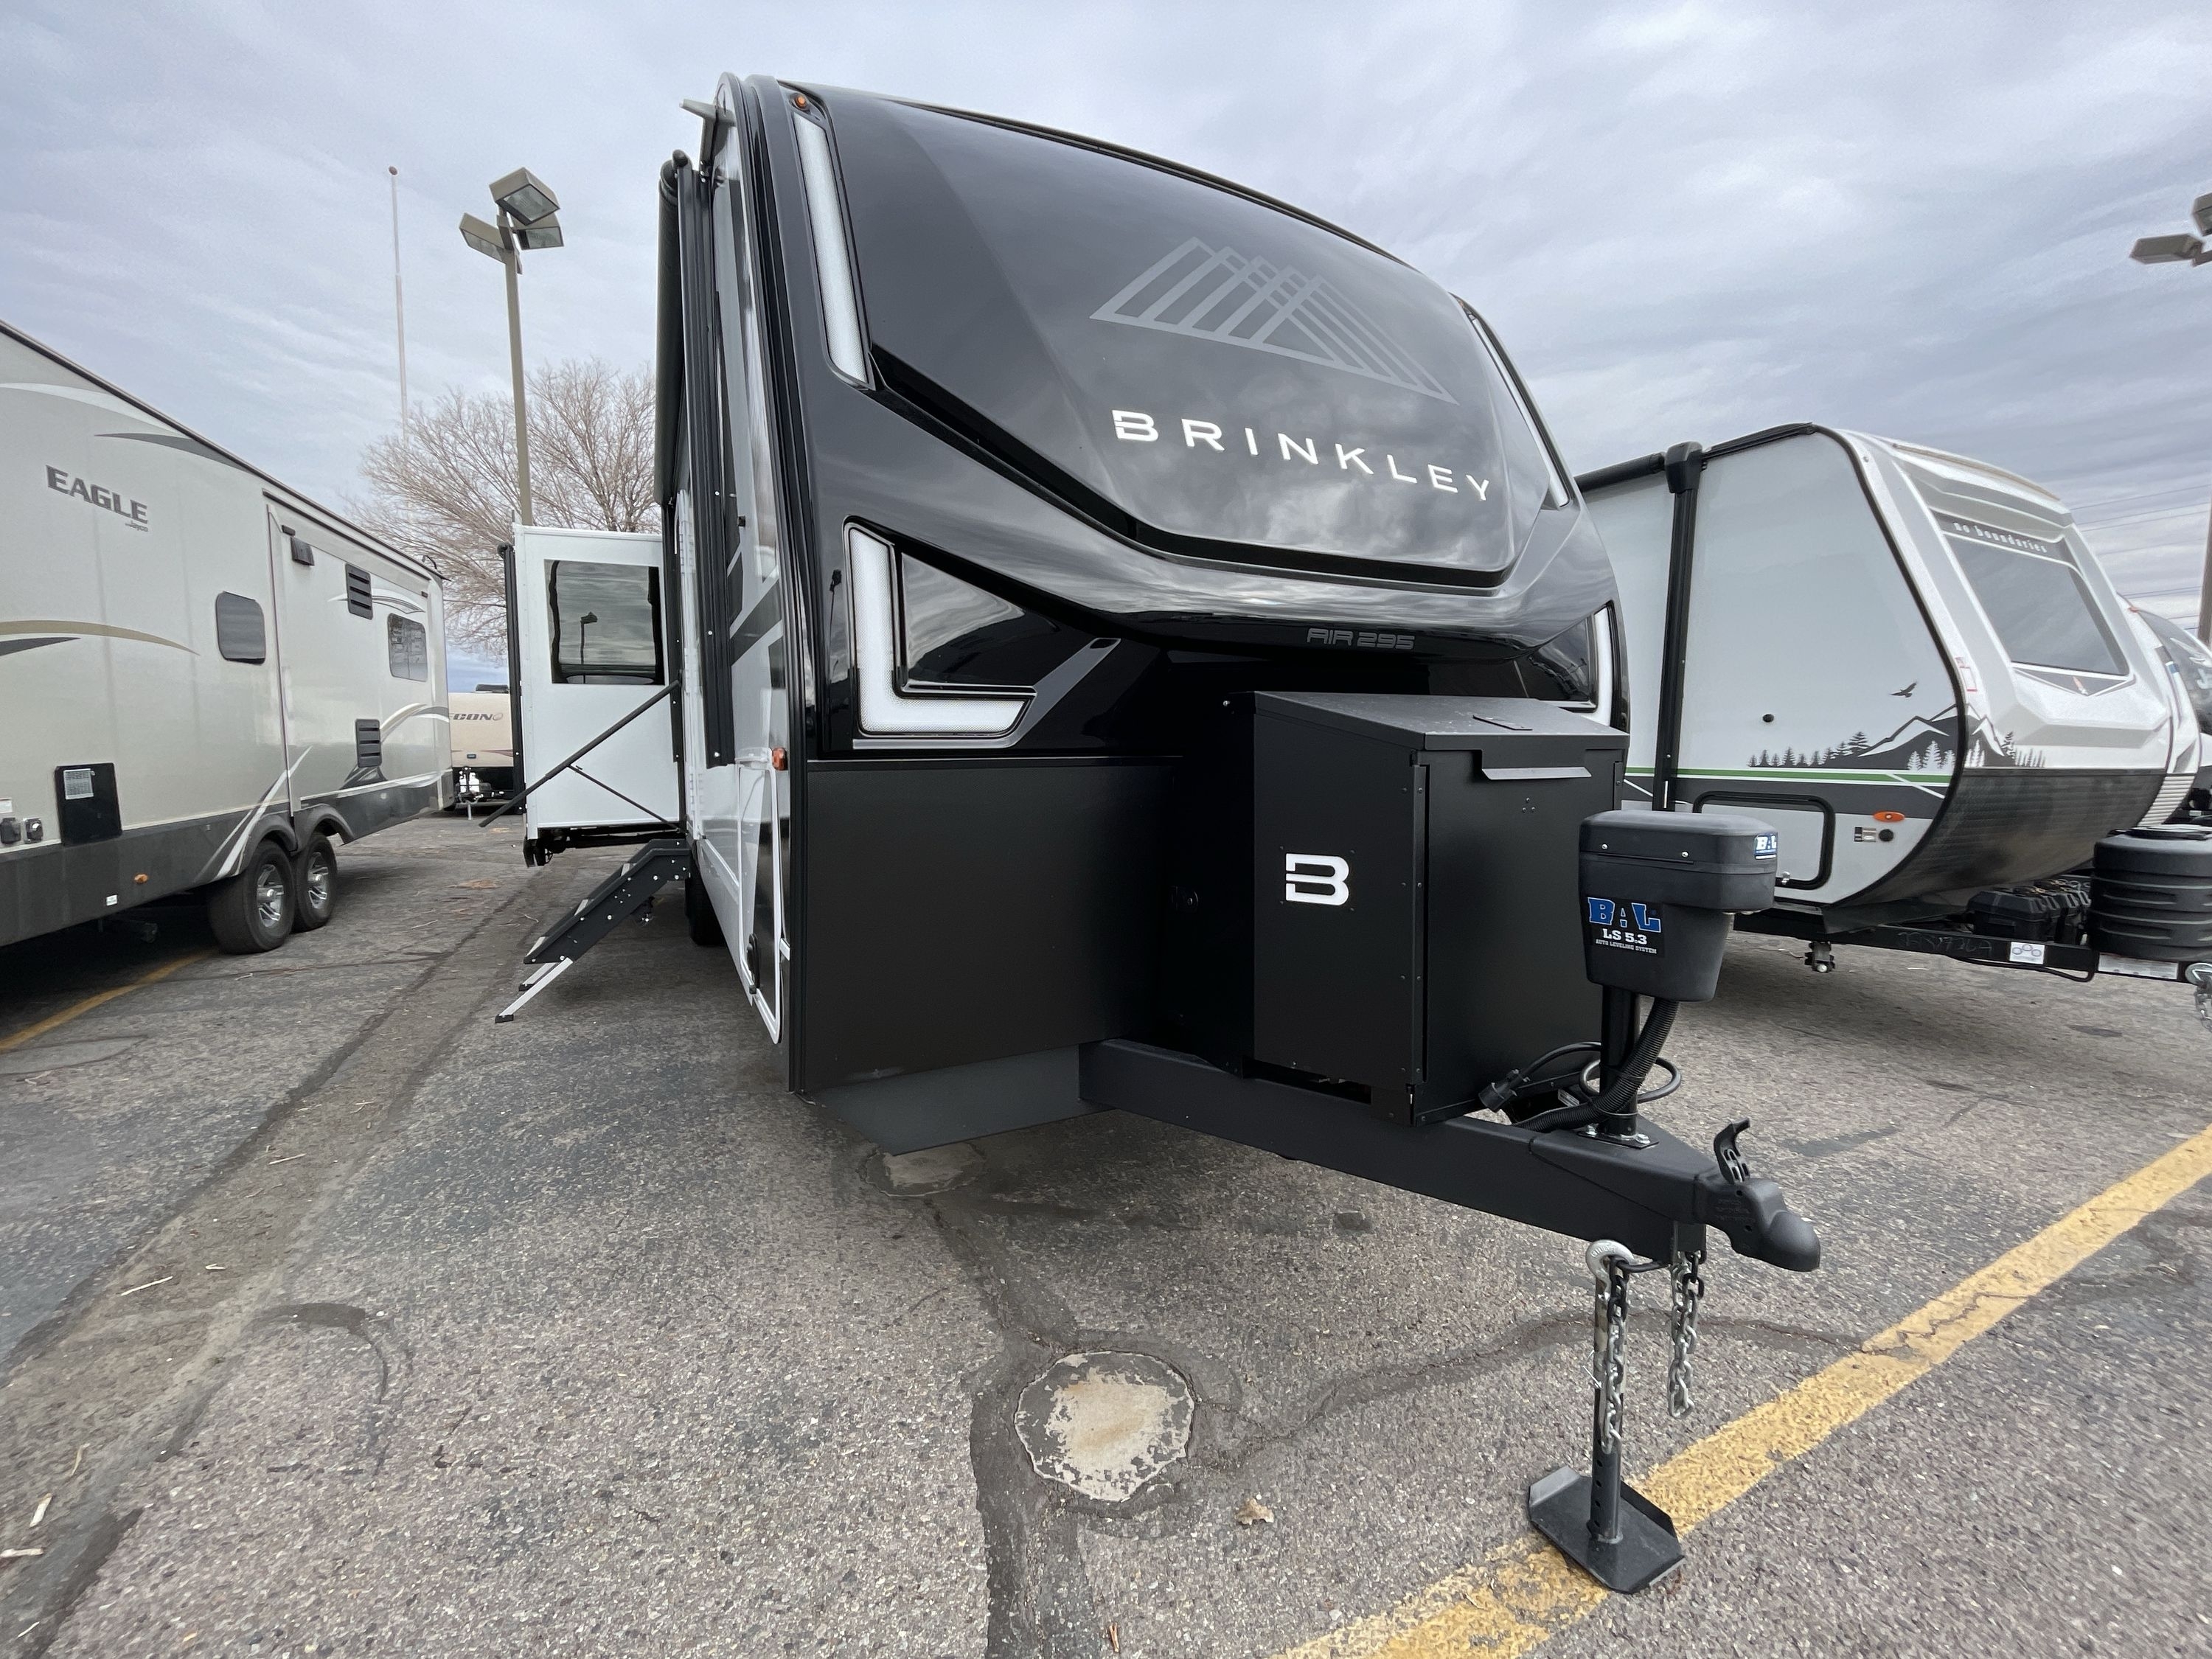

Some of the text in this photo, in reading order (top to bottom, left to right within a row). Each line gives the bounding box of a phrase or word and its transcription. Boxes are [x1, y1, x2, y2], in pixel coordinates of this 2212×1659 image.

[1112, 410, 1489, 501] BRINKLEY
[46, 465, 149, 524] EAGLE
[1974, 525, 2048, 553] boundaries
[1307, 627, 1416, 650] AIR 295
[1587, 897, 1662, 933] BAL
[1602, 928, 1648, 945] LS 5.3
[1610, 940, 1635, 950] LEVELING
[1635, 945, 1658, 954] SYSTEM
